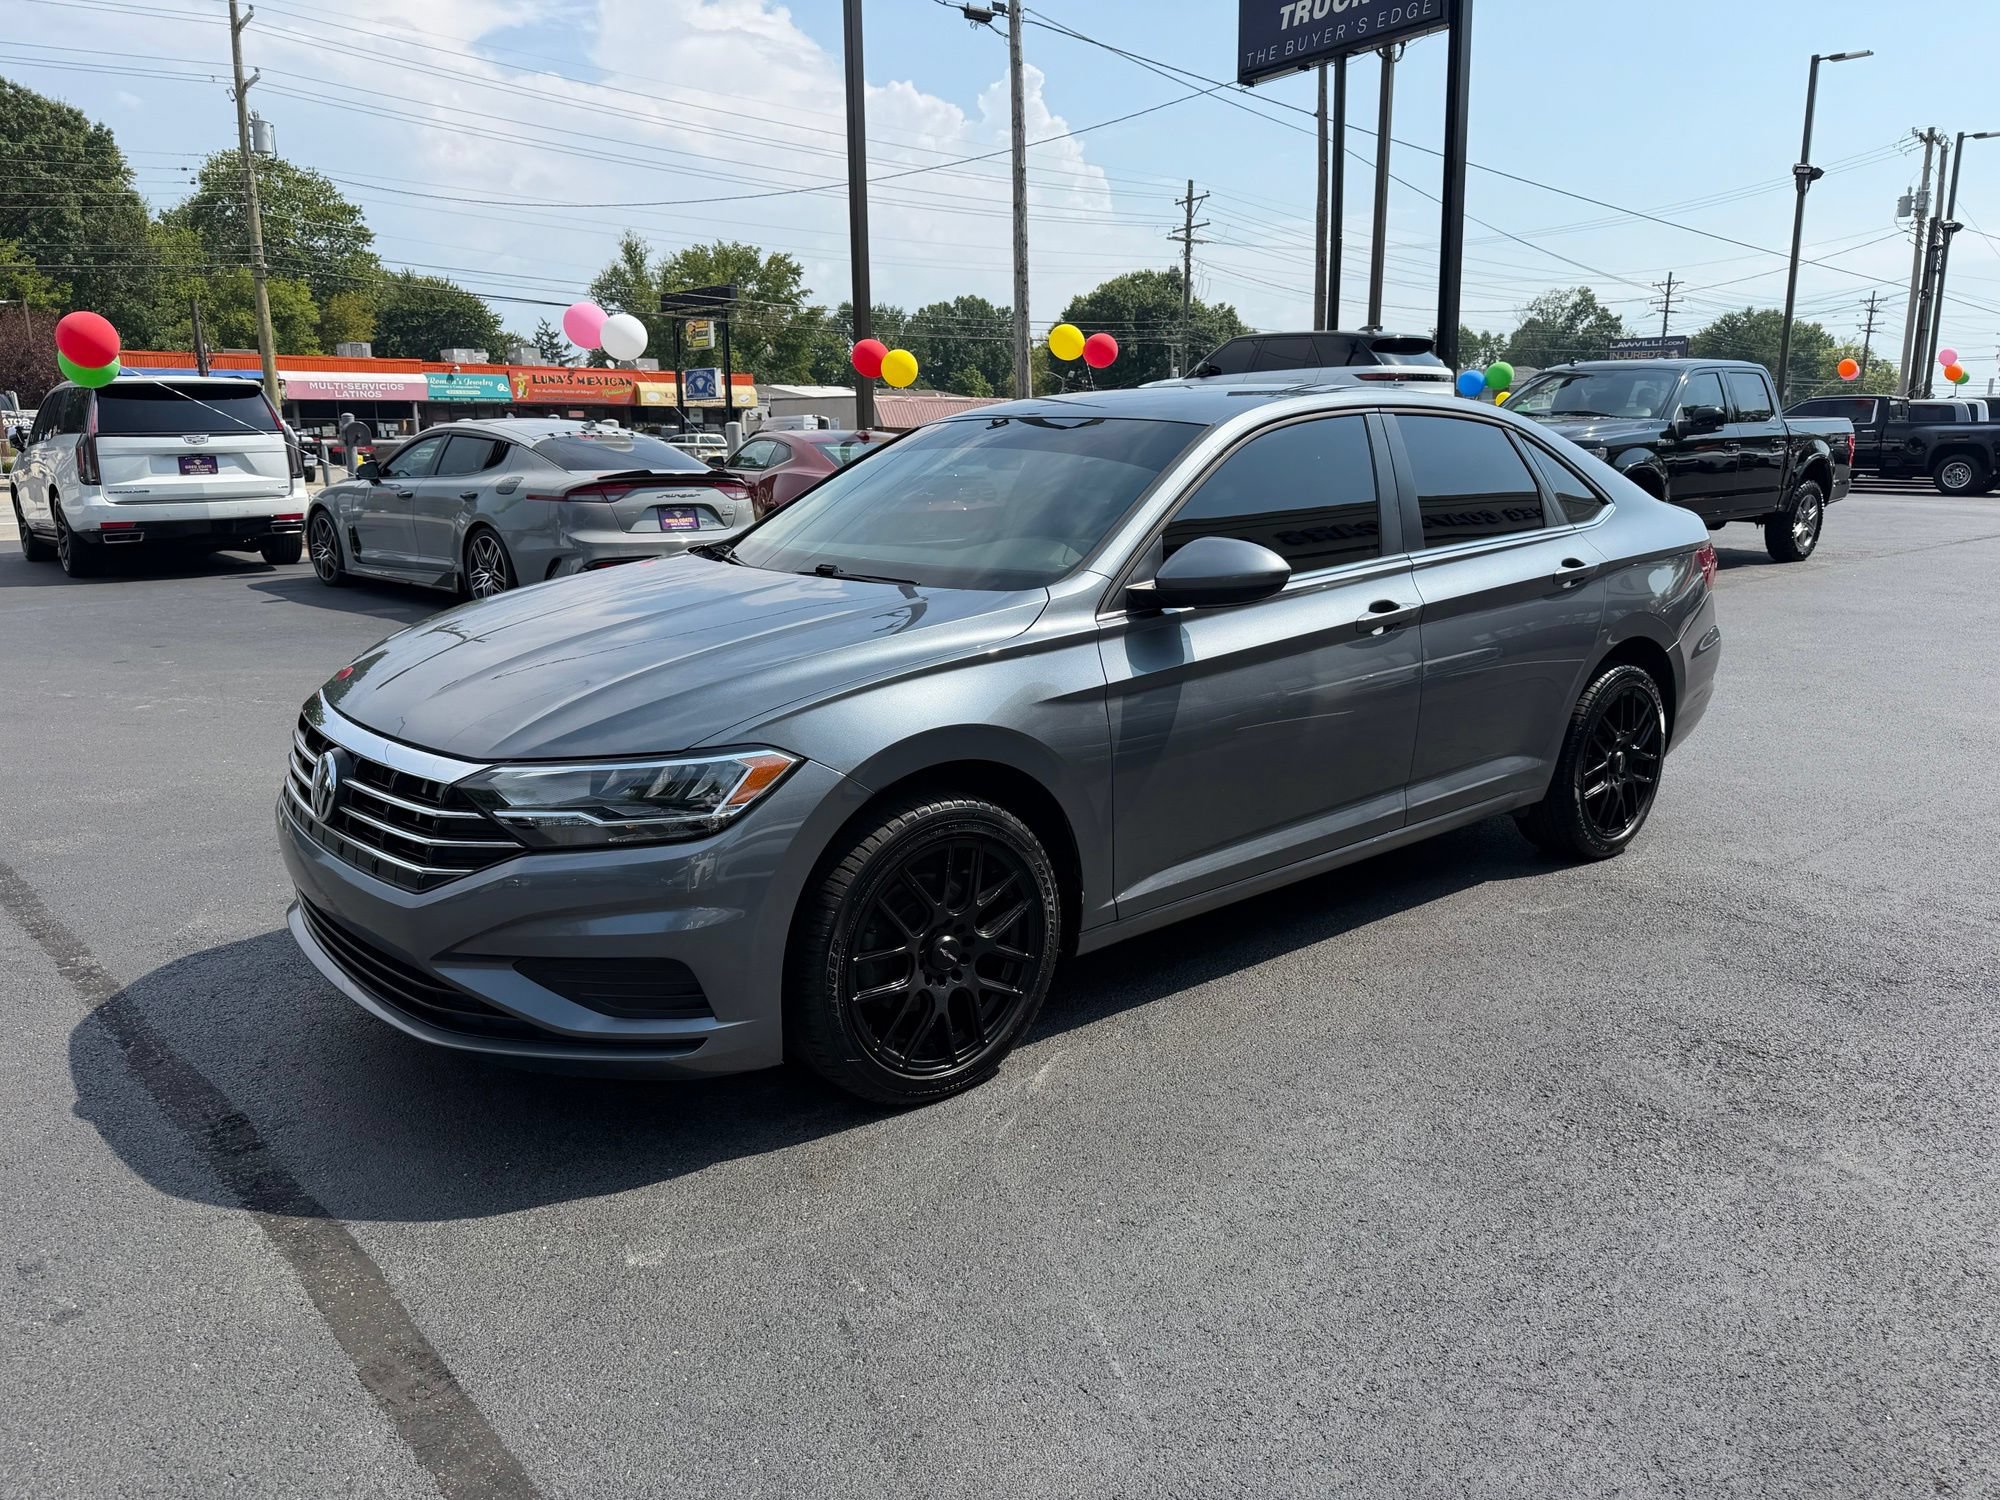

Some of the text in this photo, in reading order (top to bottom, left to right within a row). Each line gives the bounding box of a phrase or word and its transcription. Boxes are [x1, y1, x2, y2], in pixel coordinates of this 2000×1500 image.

[1279, 0, 1371, 31] TRUC
[1246, 0, 1433, 68] THE BUYER'S EDGE
[309, 382, 405, 391] MULTI-SERVICIOS
[531, 374, 633, 387] LUNA'S MEXICAN
[334, 390, 382, 398] LATINOS
